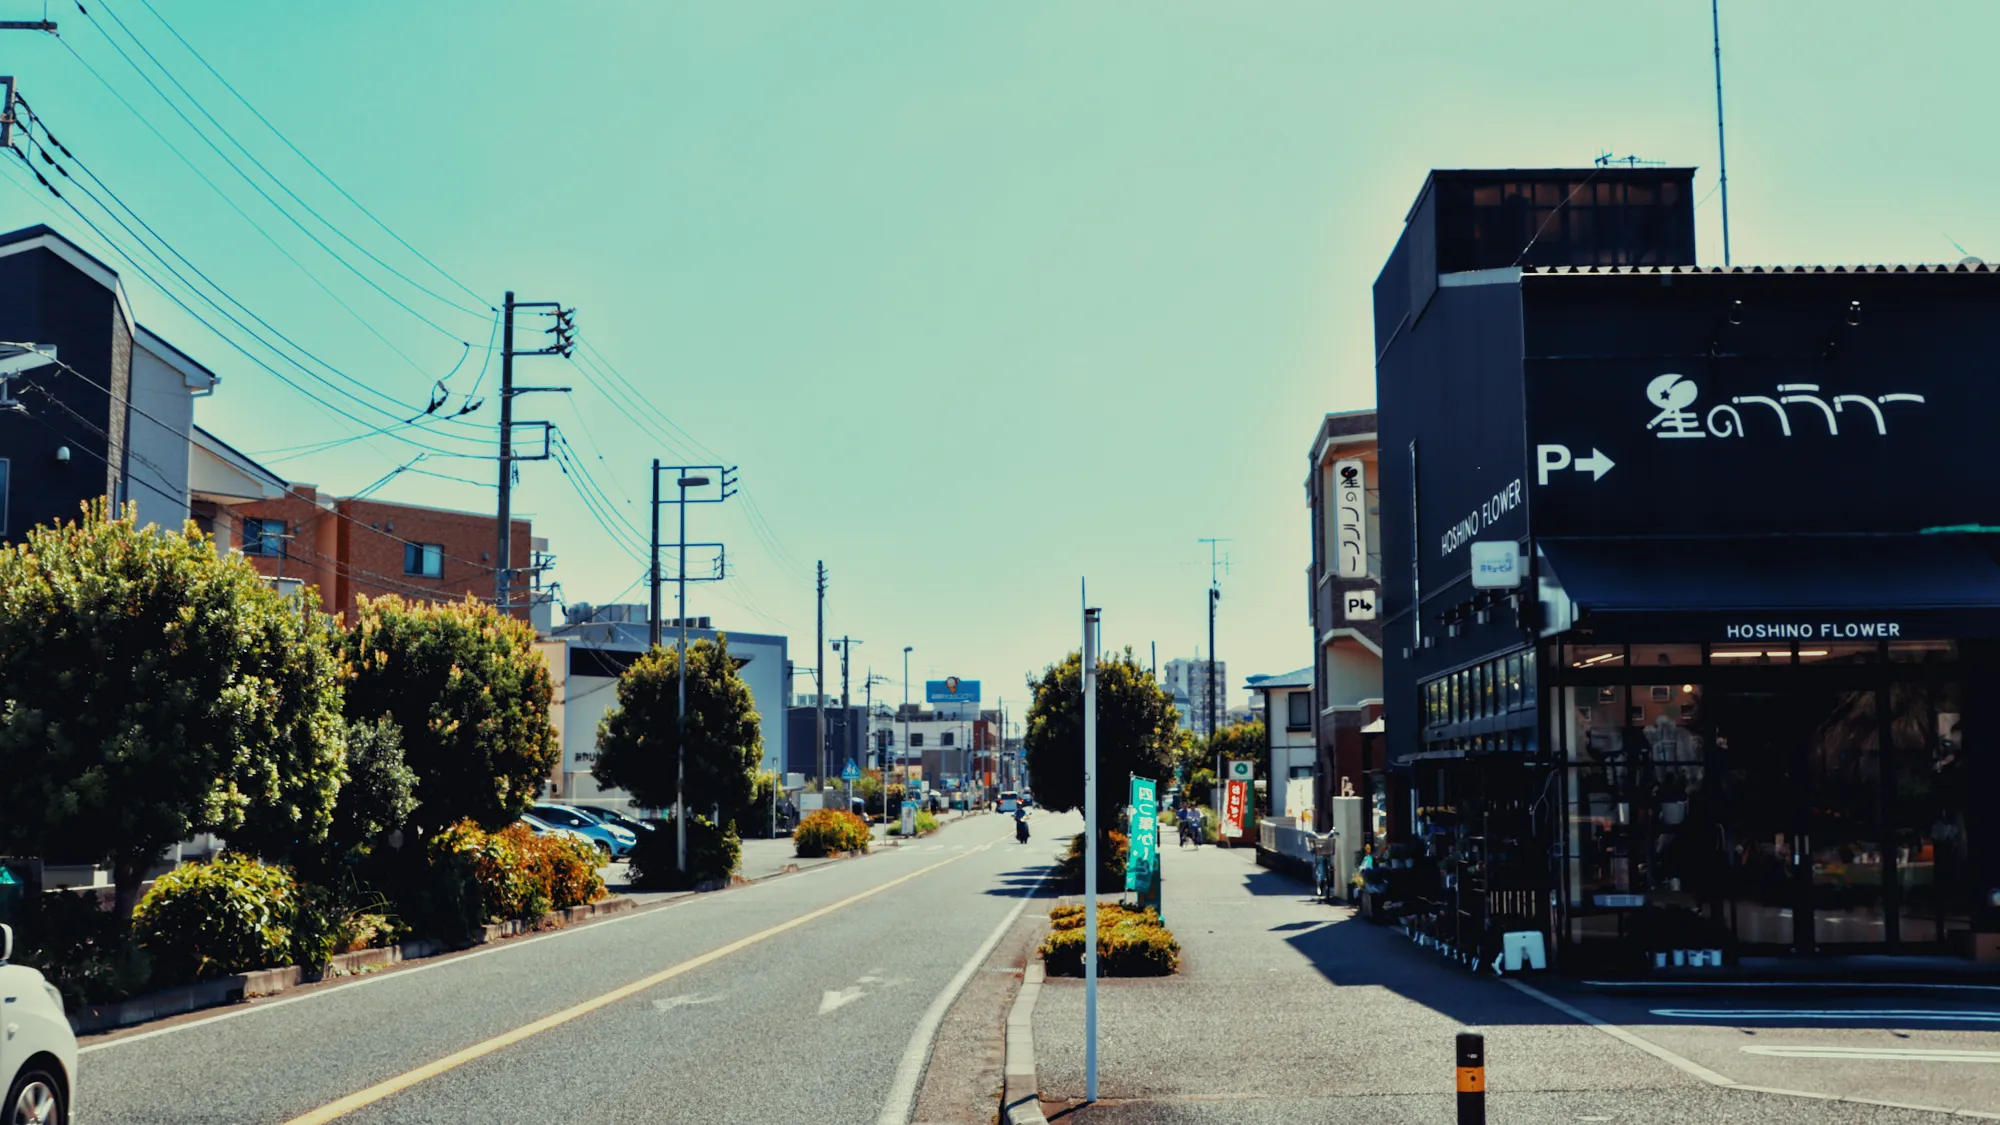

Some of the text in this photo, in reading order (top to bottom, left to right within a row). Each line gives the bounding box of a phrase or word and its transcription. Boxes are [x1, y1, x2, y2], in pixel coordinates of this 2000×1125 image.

[1646, 373, 1925, 438] 星のフラワー
[1537, 444, 1571, 485] P
[1340, 466, 1360, 572] 星のフラワー
[1441, 478, 1521, 556] HOSHINO FLOWER
[1348, 598, 1360, 613] P
[1727, 623, 1900, 638] HOSHINO FLOWER
